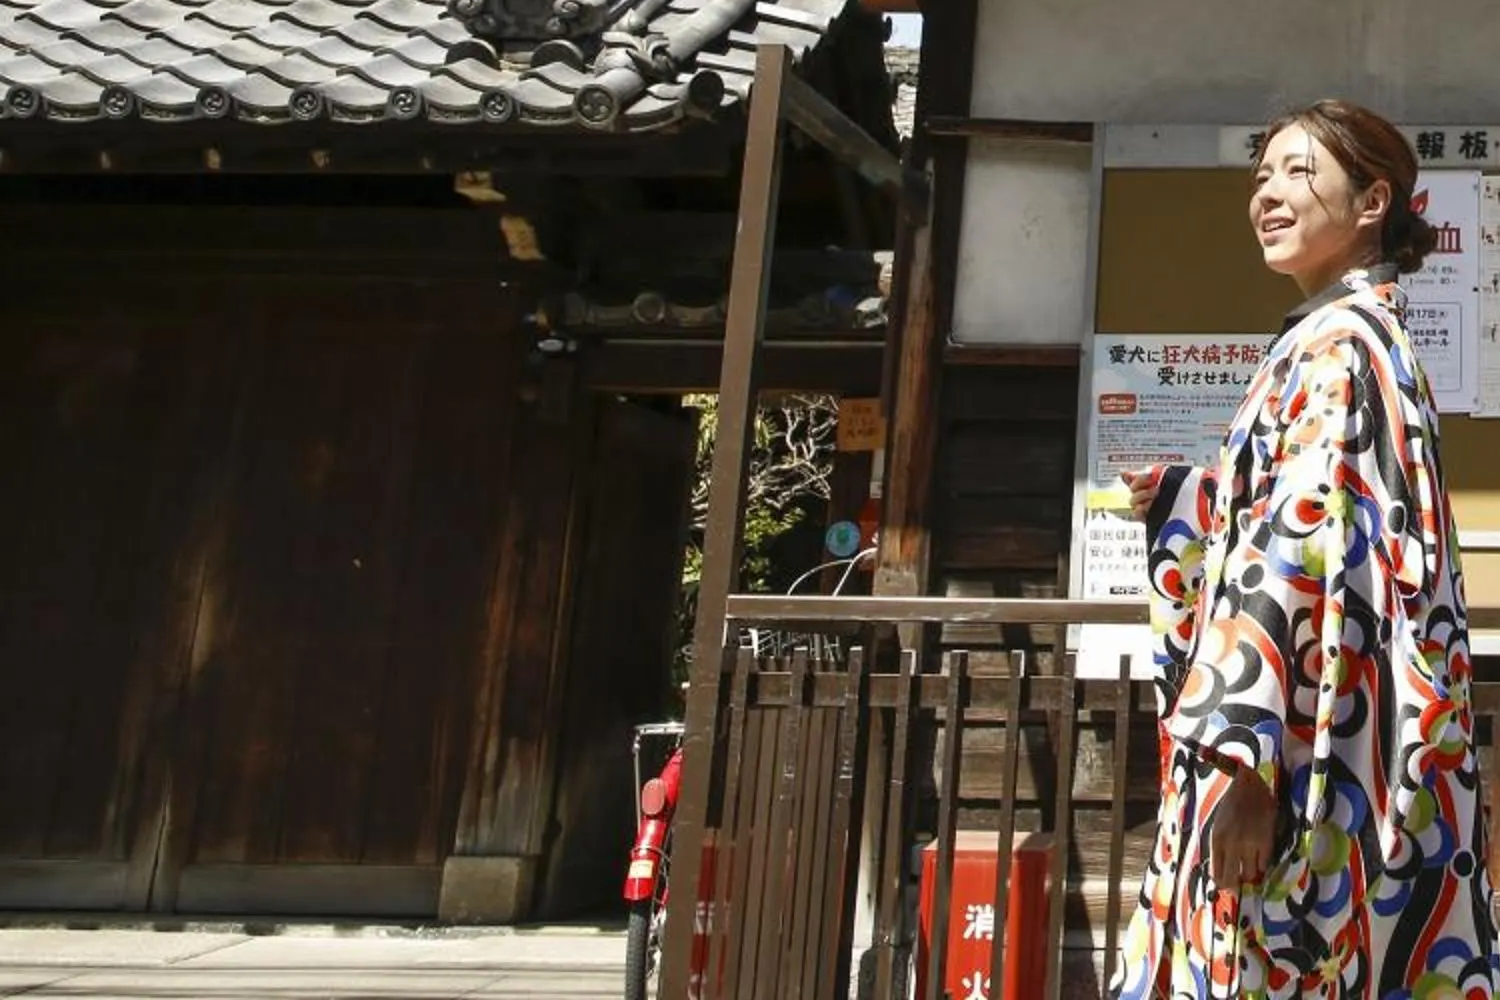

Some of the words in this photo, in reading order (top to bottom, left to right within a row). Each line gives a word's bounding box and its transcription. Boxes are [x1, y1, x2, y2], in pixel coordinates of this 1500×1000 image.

[1109, 344, 1267, 364] 愛犬に狂犬病予防
